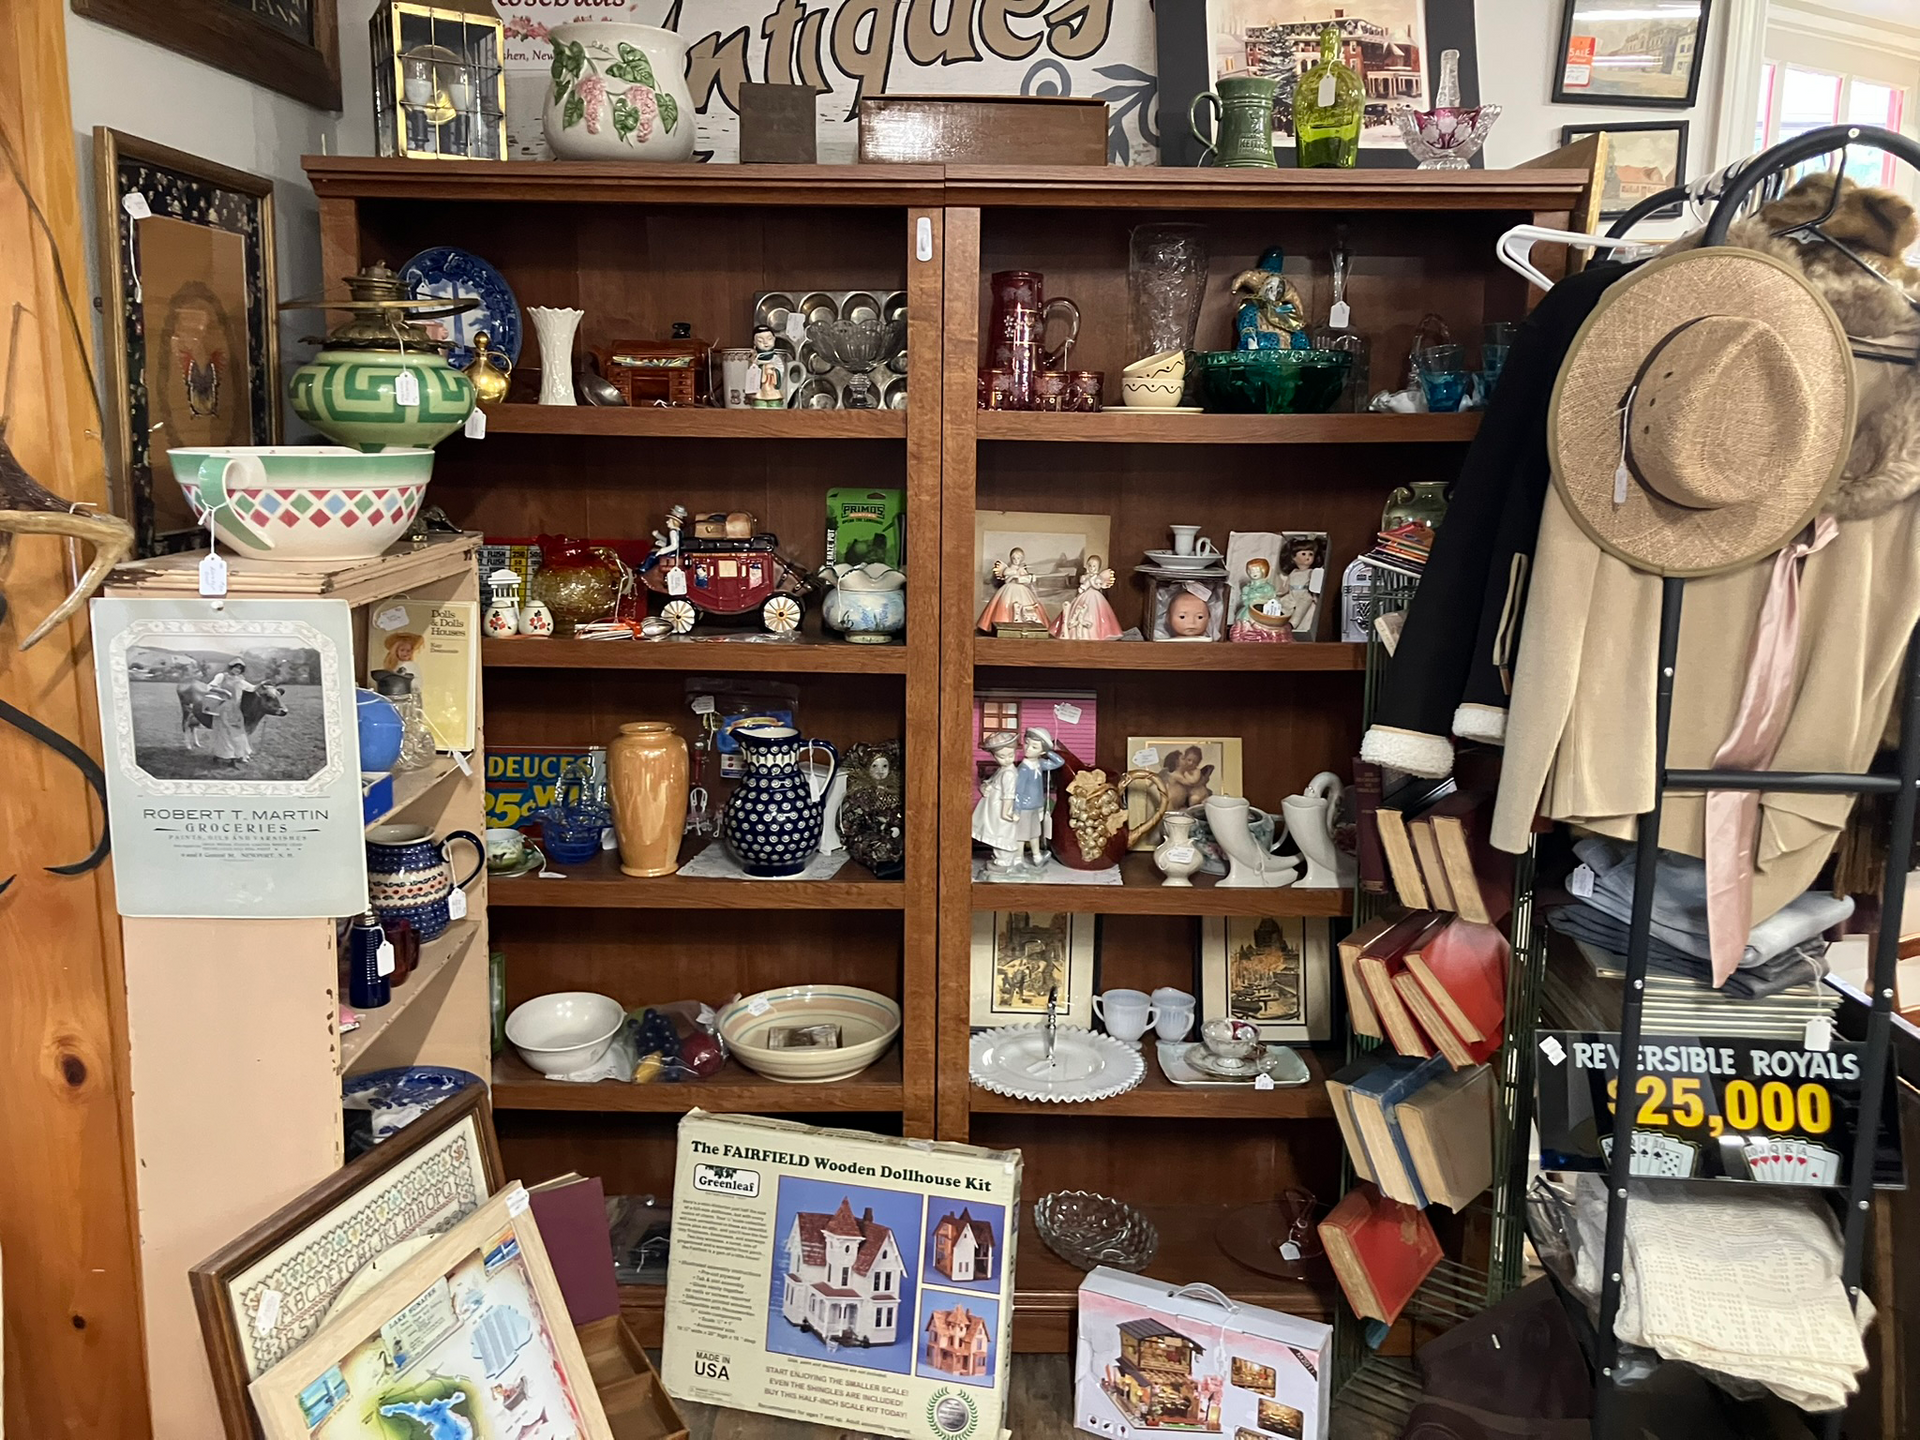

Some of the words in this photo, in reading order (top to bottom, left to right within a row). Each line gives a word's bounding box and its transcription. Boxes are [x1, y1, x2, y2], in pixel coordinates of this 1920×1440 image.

[664, 0, 1112, 122] ntiques
[1570, 47, 1590, 57] SALE
[843, 505, 884, 516] PRIMOS
[431, 609, 456, 619] Dolls
[440, 618, 464, 628] Dolls
[431, 627, 466, 637] Houses
[487, 756, 593, 778] DEUCES
[143, 808, 226, 820] ROBERT
[231, 809, 248, 821] T.
[252, 809, 329, 820] MARTIN
[185, 822, 288, 833] GROCERIES
[1572, 1042, 1736, 1075] REVERSIBLE
[1752, 1050, 1860, 1080] ROYALS
[691, 1140, 719, 1156] The
[723, 1144, 810, 1168] FAIRFIELD
[814, 1157, 876, 1177] Wooden
[880, 1165, 961, 1188] Dollhouse
[965, 1177, 992, 1192] Kit
[698, 1175, 756, 1193] Greenleaf
[696, 1351, 720, 1363] MADE
[722, 1355, 731, 1364] IN
[694, 1360, 730, 1381] USA
[766, 1366, 788, 1376] START
[790, 1370, 827, 1383] ENJOYING
[830, 1377, 843, 1385] THE
[845, 1379, 880, 1392] SMALLER
[882, 1385, 908, 1396] SCALE!
[770, 1378, 789, 1387] EVEN
[791, 1381, 804, 1390] THE
[807, 1384, 843, 1396] SHINGLES
[845, 1391, 860, 1399] ARE
[863, 1394, 903, 1407] INCLUDED!
[765, 1388, 778, 1396] BUY
[781, 1391, 797, 1400] THIS
[799, 1394, 838, 1407] HALF-INCH
[840, 1401, 864, 1411] SCALE
[866, 1405, 879, 1414] KIT
[881, 1408, 907, 1419] TODAY!
